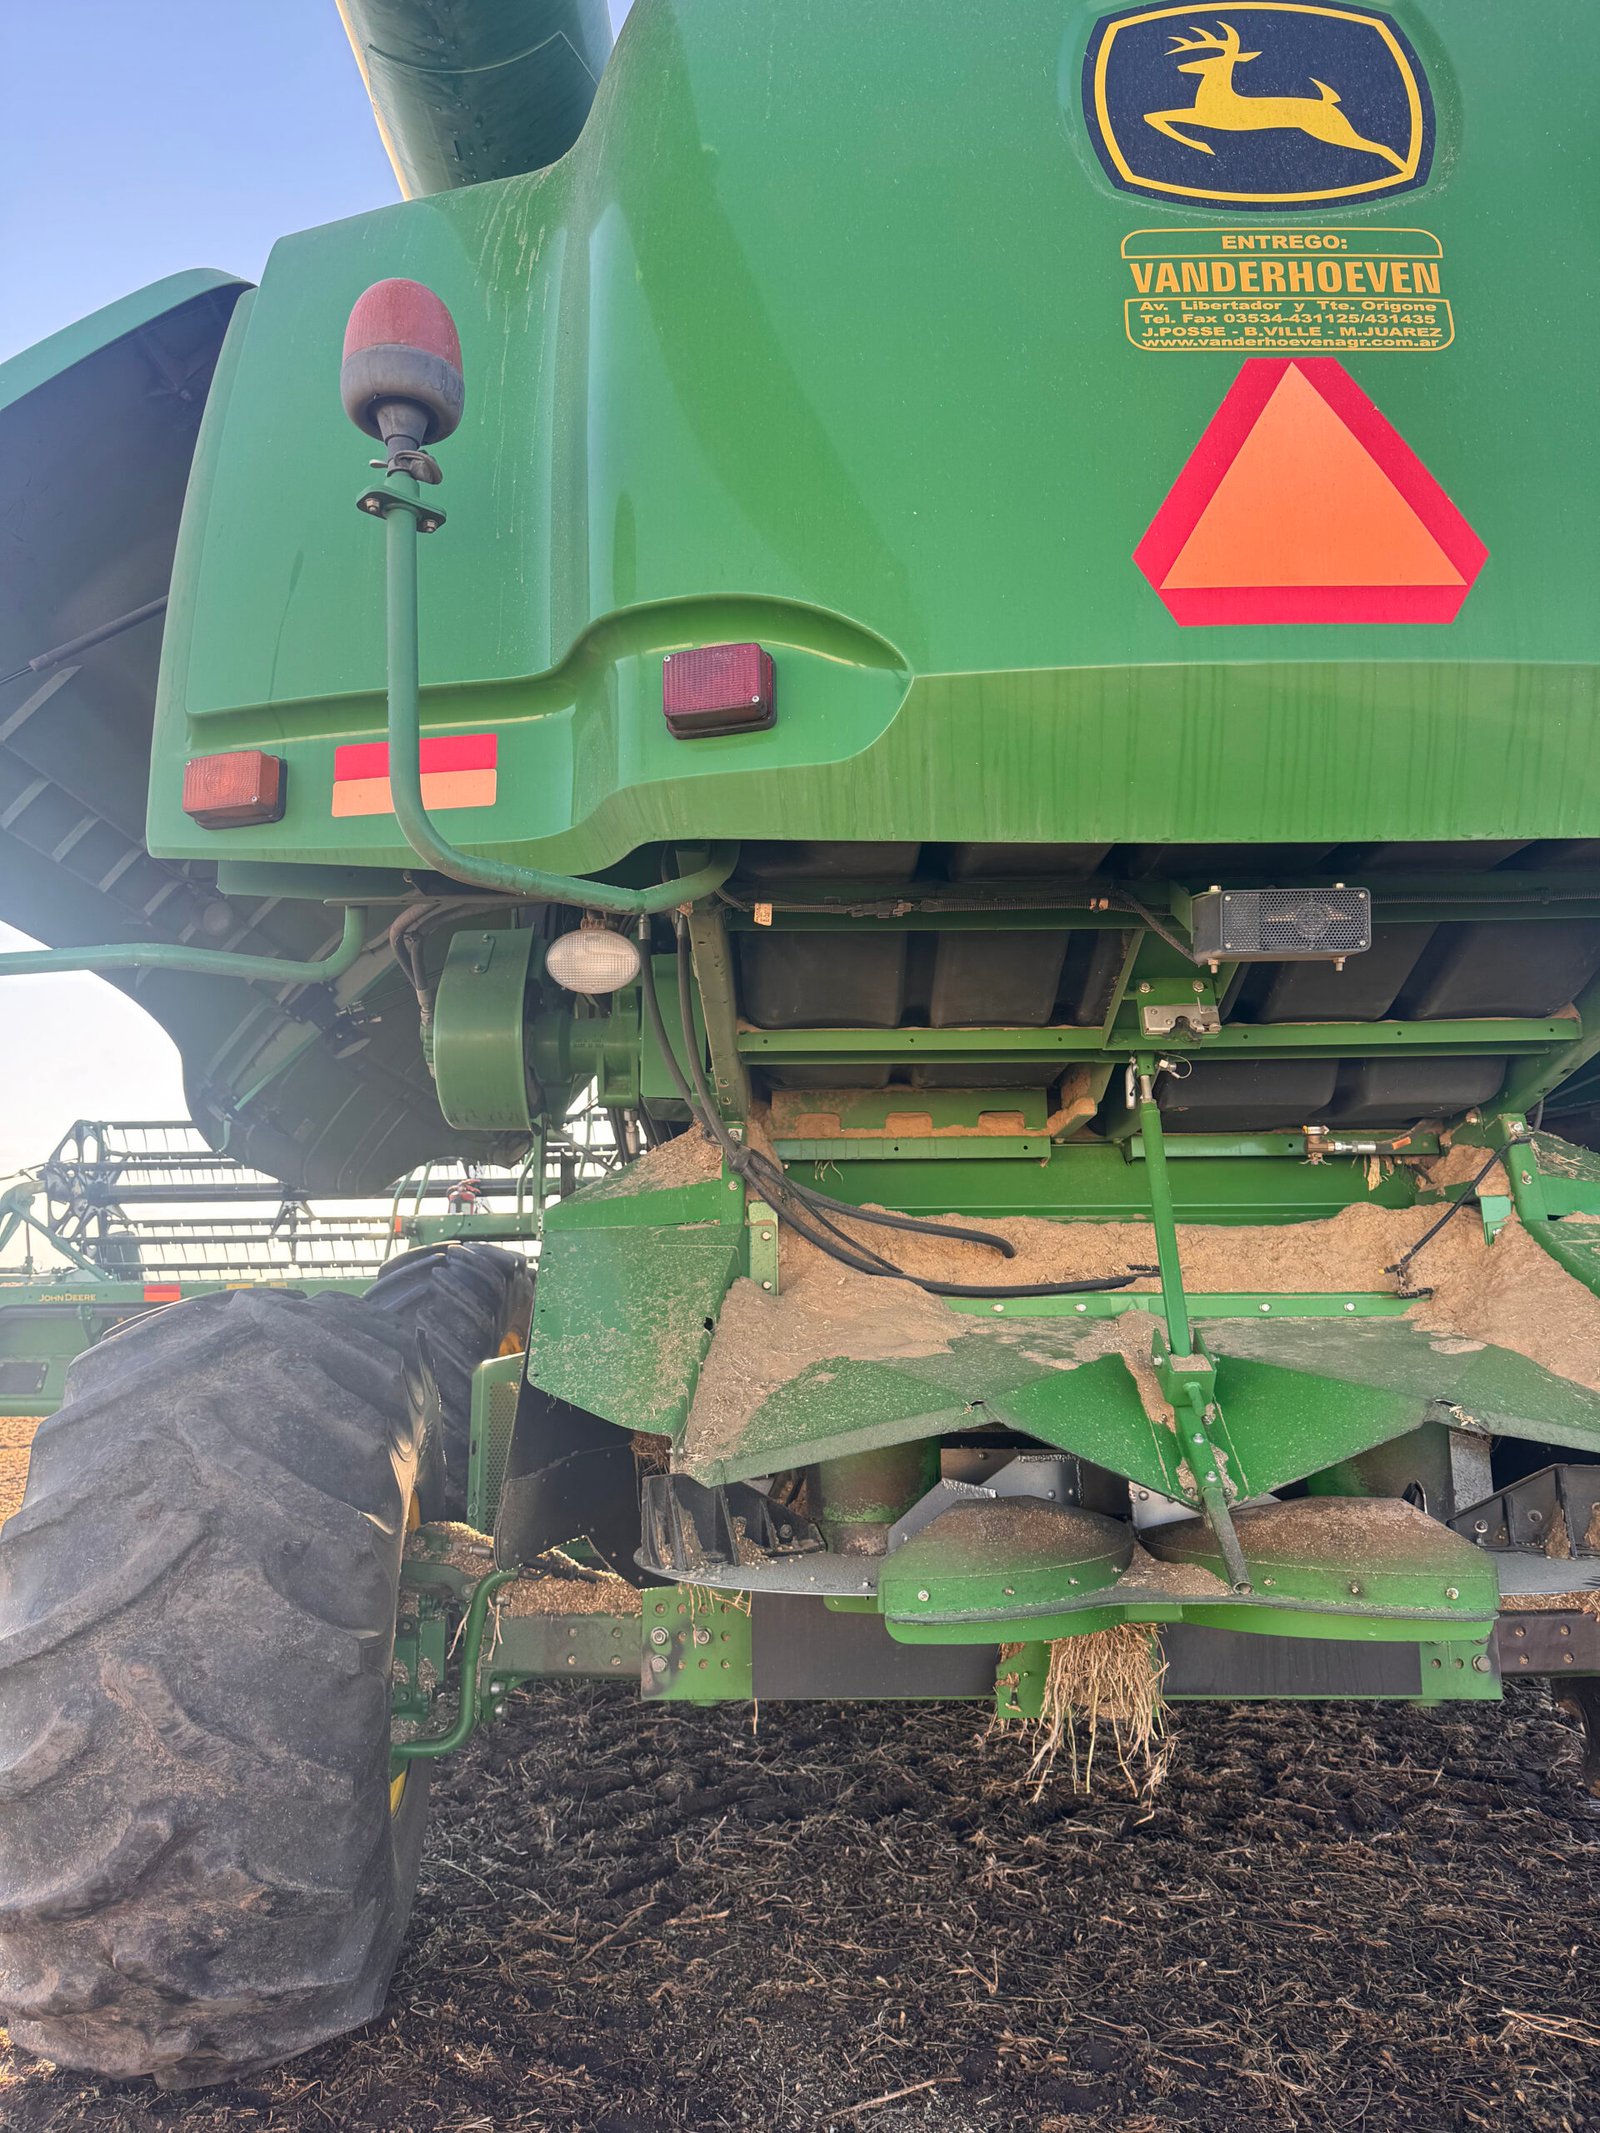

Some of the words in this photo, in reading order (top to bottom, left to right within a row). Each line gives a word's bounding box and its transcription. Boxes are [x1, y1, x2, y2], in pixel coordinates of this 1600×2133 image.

[1222, 235, 1347, 250] ENTREGO:
[1130, 261, 1441, 294] VANDERHOEVEN
[1140, 302, 1168, 311] Av.
[1181, 301, 1282, 311] Libertador
[1293, 303, 1305, 313] y
[1317, 301, 1355, 311] Tte.
[1361, 301, 1437, 313] Origone
[1140, 314, 1176, 324] Tel.
[1182, 314, 1217, 324] Fax
[1223, 313, 1436, 324] 03534-431125/431435
[1142, 327, 1226, 337] J.POSSE
[1244, 327, 1322, 337] B.VILLE
[1340, 327, 1443, 337] M.JUAREZ
[1142, 337, 1440, 348] www.vanderhoevenagr.com.ar
[39, 1294, 64, 1303] JOHN
[65, 1293, 97, 1302] DEERE
